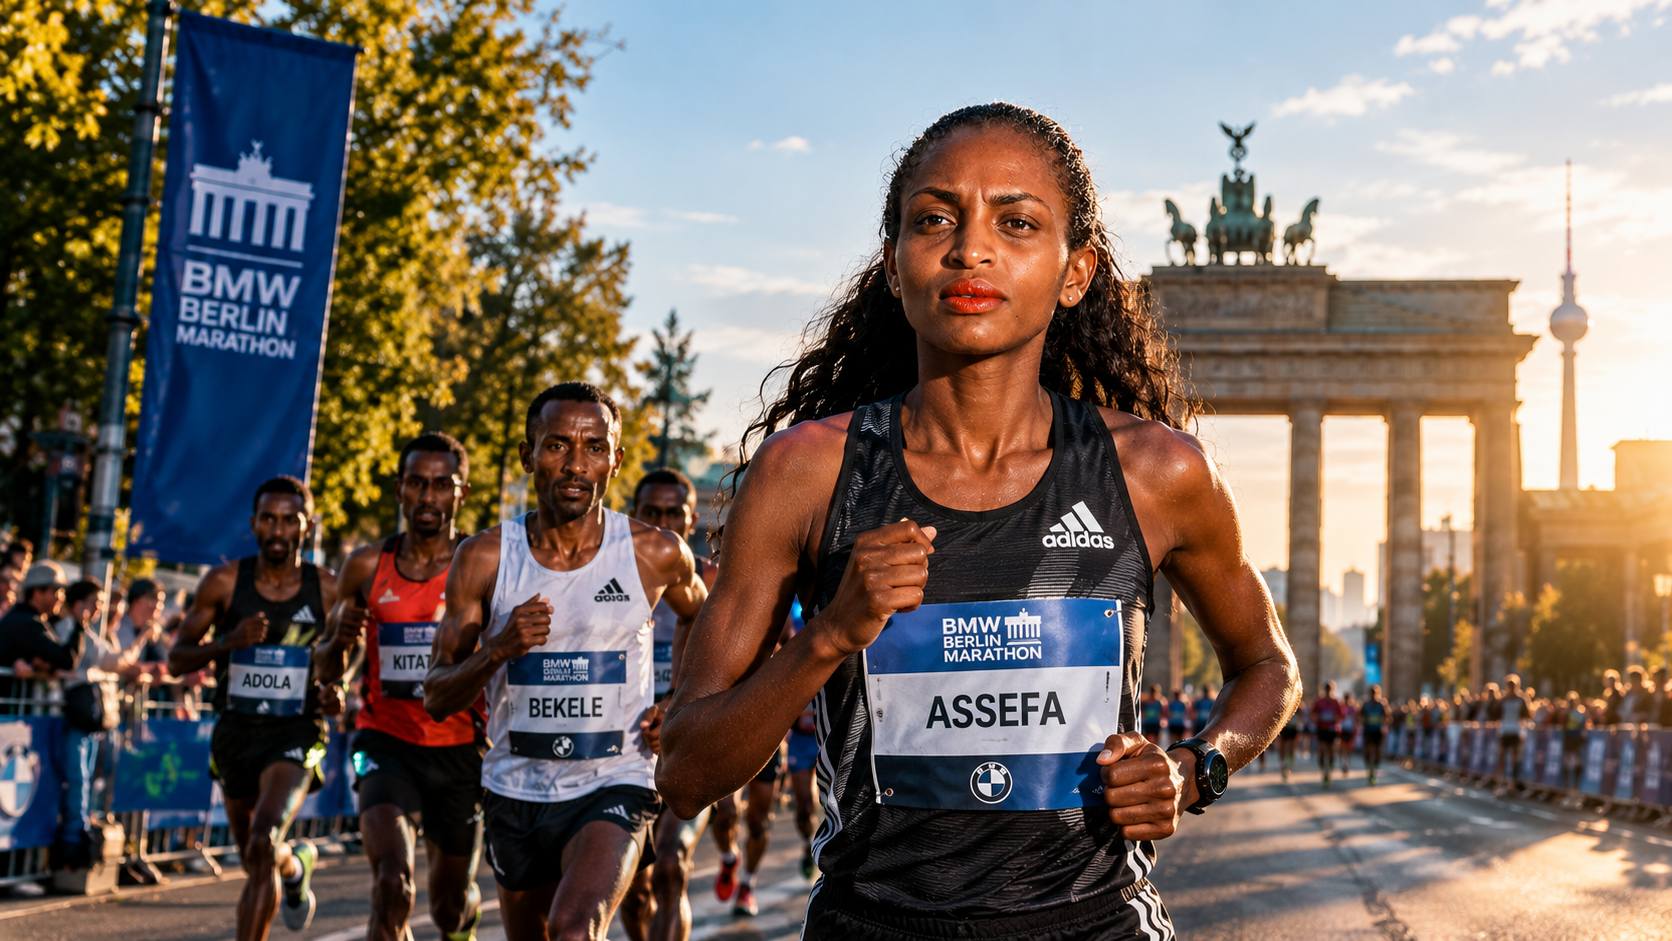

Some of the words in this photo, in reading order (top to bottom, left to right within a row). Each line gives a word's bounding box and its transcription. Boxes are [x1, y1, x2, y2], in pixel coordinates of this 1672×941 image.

[182, 259, 301, 309] BMW
[179, 296, 288, 336] BERLIN
[175, 324, 296, 360] MARATHON
[1042, 530, 1115, 549] adidas
[942, 616, 1001, 635] BMW
[943, 634, 1001, 648] BERLIN
[944, 645, 1042, 662] MARATHON
[543, 659, 571, 668] BMW
[242, 672, 291, 690] ADOLA
[529, 697, 603, 718] BEKELE
[926, 691, 1066, 729] ASSEFA
